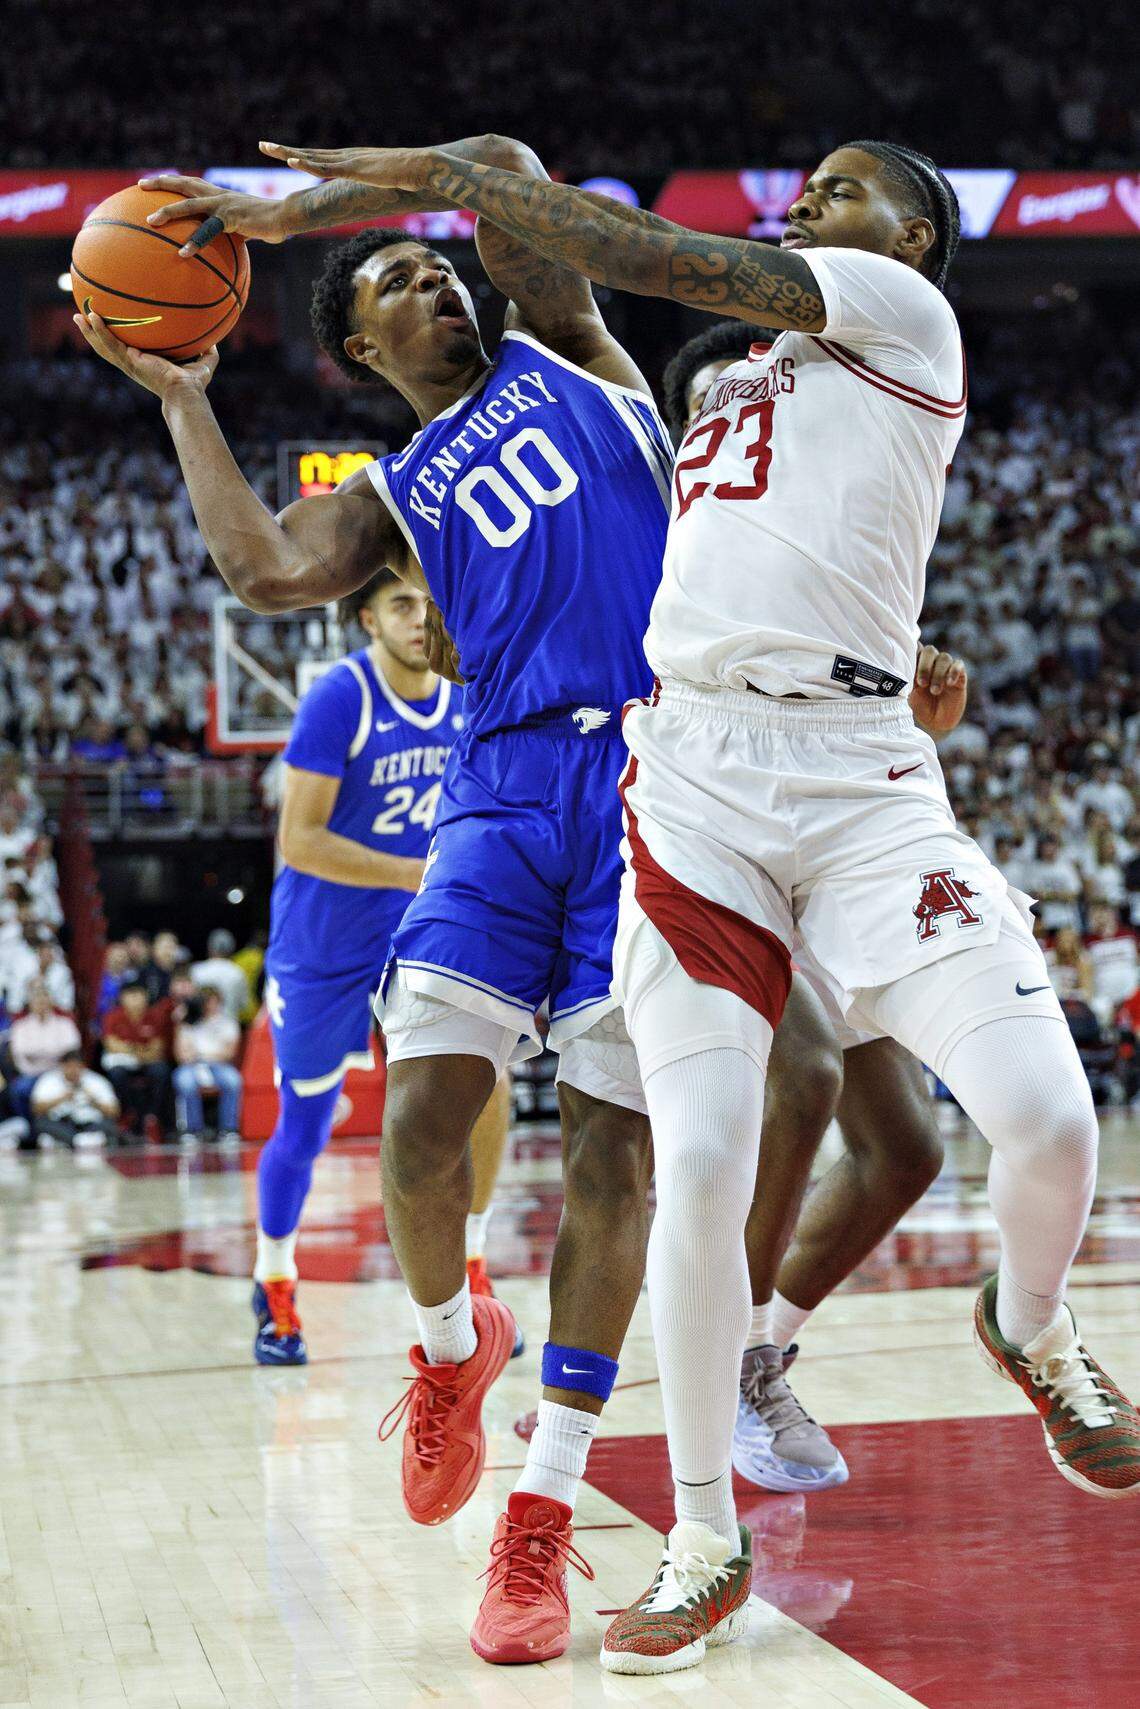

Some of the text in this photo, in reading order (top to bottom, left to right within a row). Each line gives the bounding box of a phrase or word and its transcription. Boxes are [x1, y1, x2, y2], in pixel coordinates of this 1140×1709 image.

[672, 252, 729, 303] 23
[409, 371, 559, 531] KENTUCKY
[676, 398, 776, 522] 23
[454, 427, 580, 548] 00
[881, 680, 894, 692] 48
[369, 745, 451, 787] KENTUC
[371, 780, 443, 835] 24
